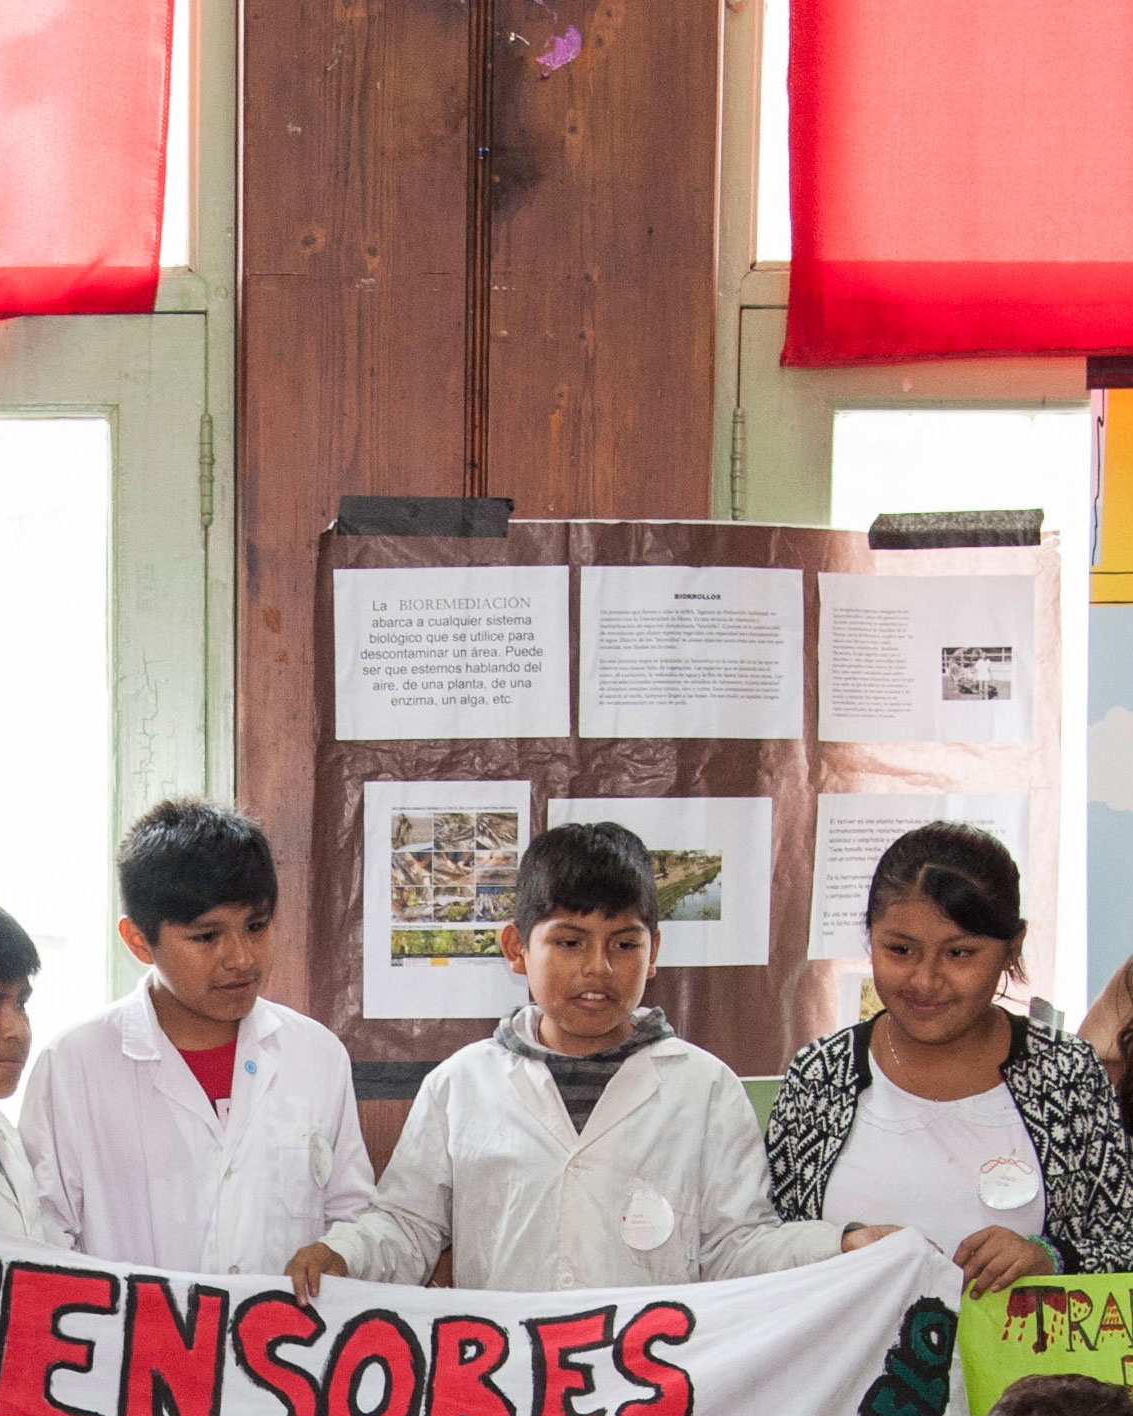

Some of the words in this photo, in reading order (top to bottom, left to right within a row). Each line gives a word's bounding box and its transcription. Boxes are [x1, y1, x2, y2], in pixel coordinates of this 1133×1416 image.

[372, 600, 387, 611] La
[371, 617, 413, 628] abarca
[416, 618, 424, 628] a
[428, 615, 482, 630] cualquier
[486, 615, 532, 627] sistema
[369, 632, 422, 646] biológico
[426, 634, 449, 646] que
[452, 633, 467, 643] se
[470, 631, 504, 643] utilice
[508, 632, 535, 645] para
[360, 648, 448, 660] descontaminar
[452, 648, 467, 658] un
[505, 645, 544, 657] Puede
[362, 665, 381, 676] ser
[385, 665, 408, 678] que
[411, 663, 462, 675] estemos
[466, 662, 520, 674] hablando
[524, 661, 542, 673] del
[402, 679, 418, 690] de
[421, 680, 444, 690] una
[491, 678, 506, 689] de
[510, 678, 532, 689] una
[441, 695, 456, 706] un
